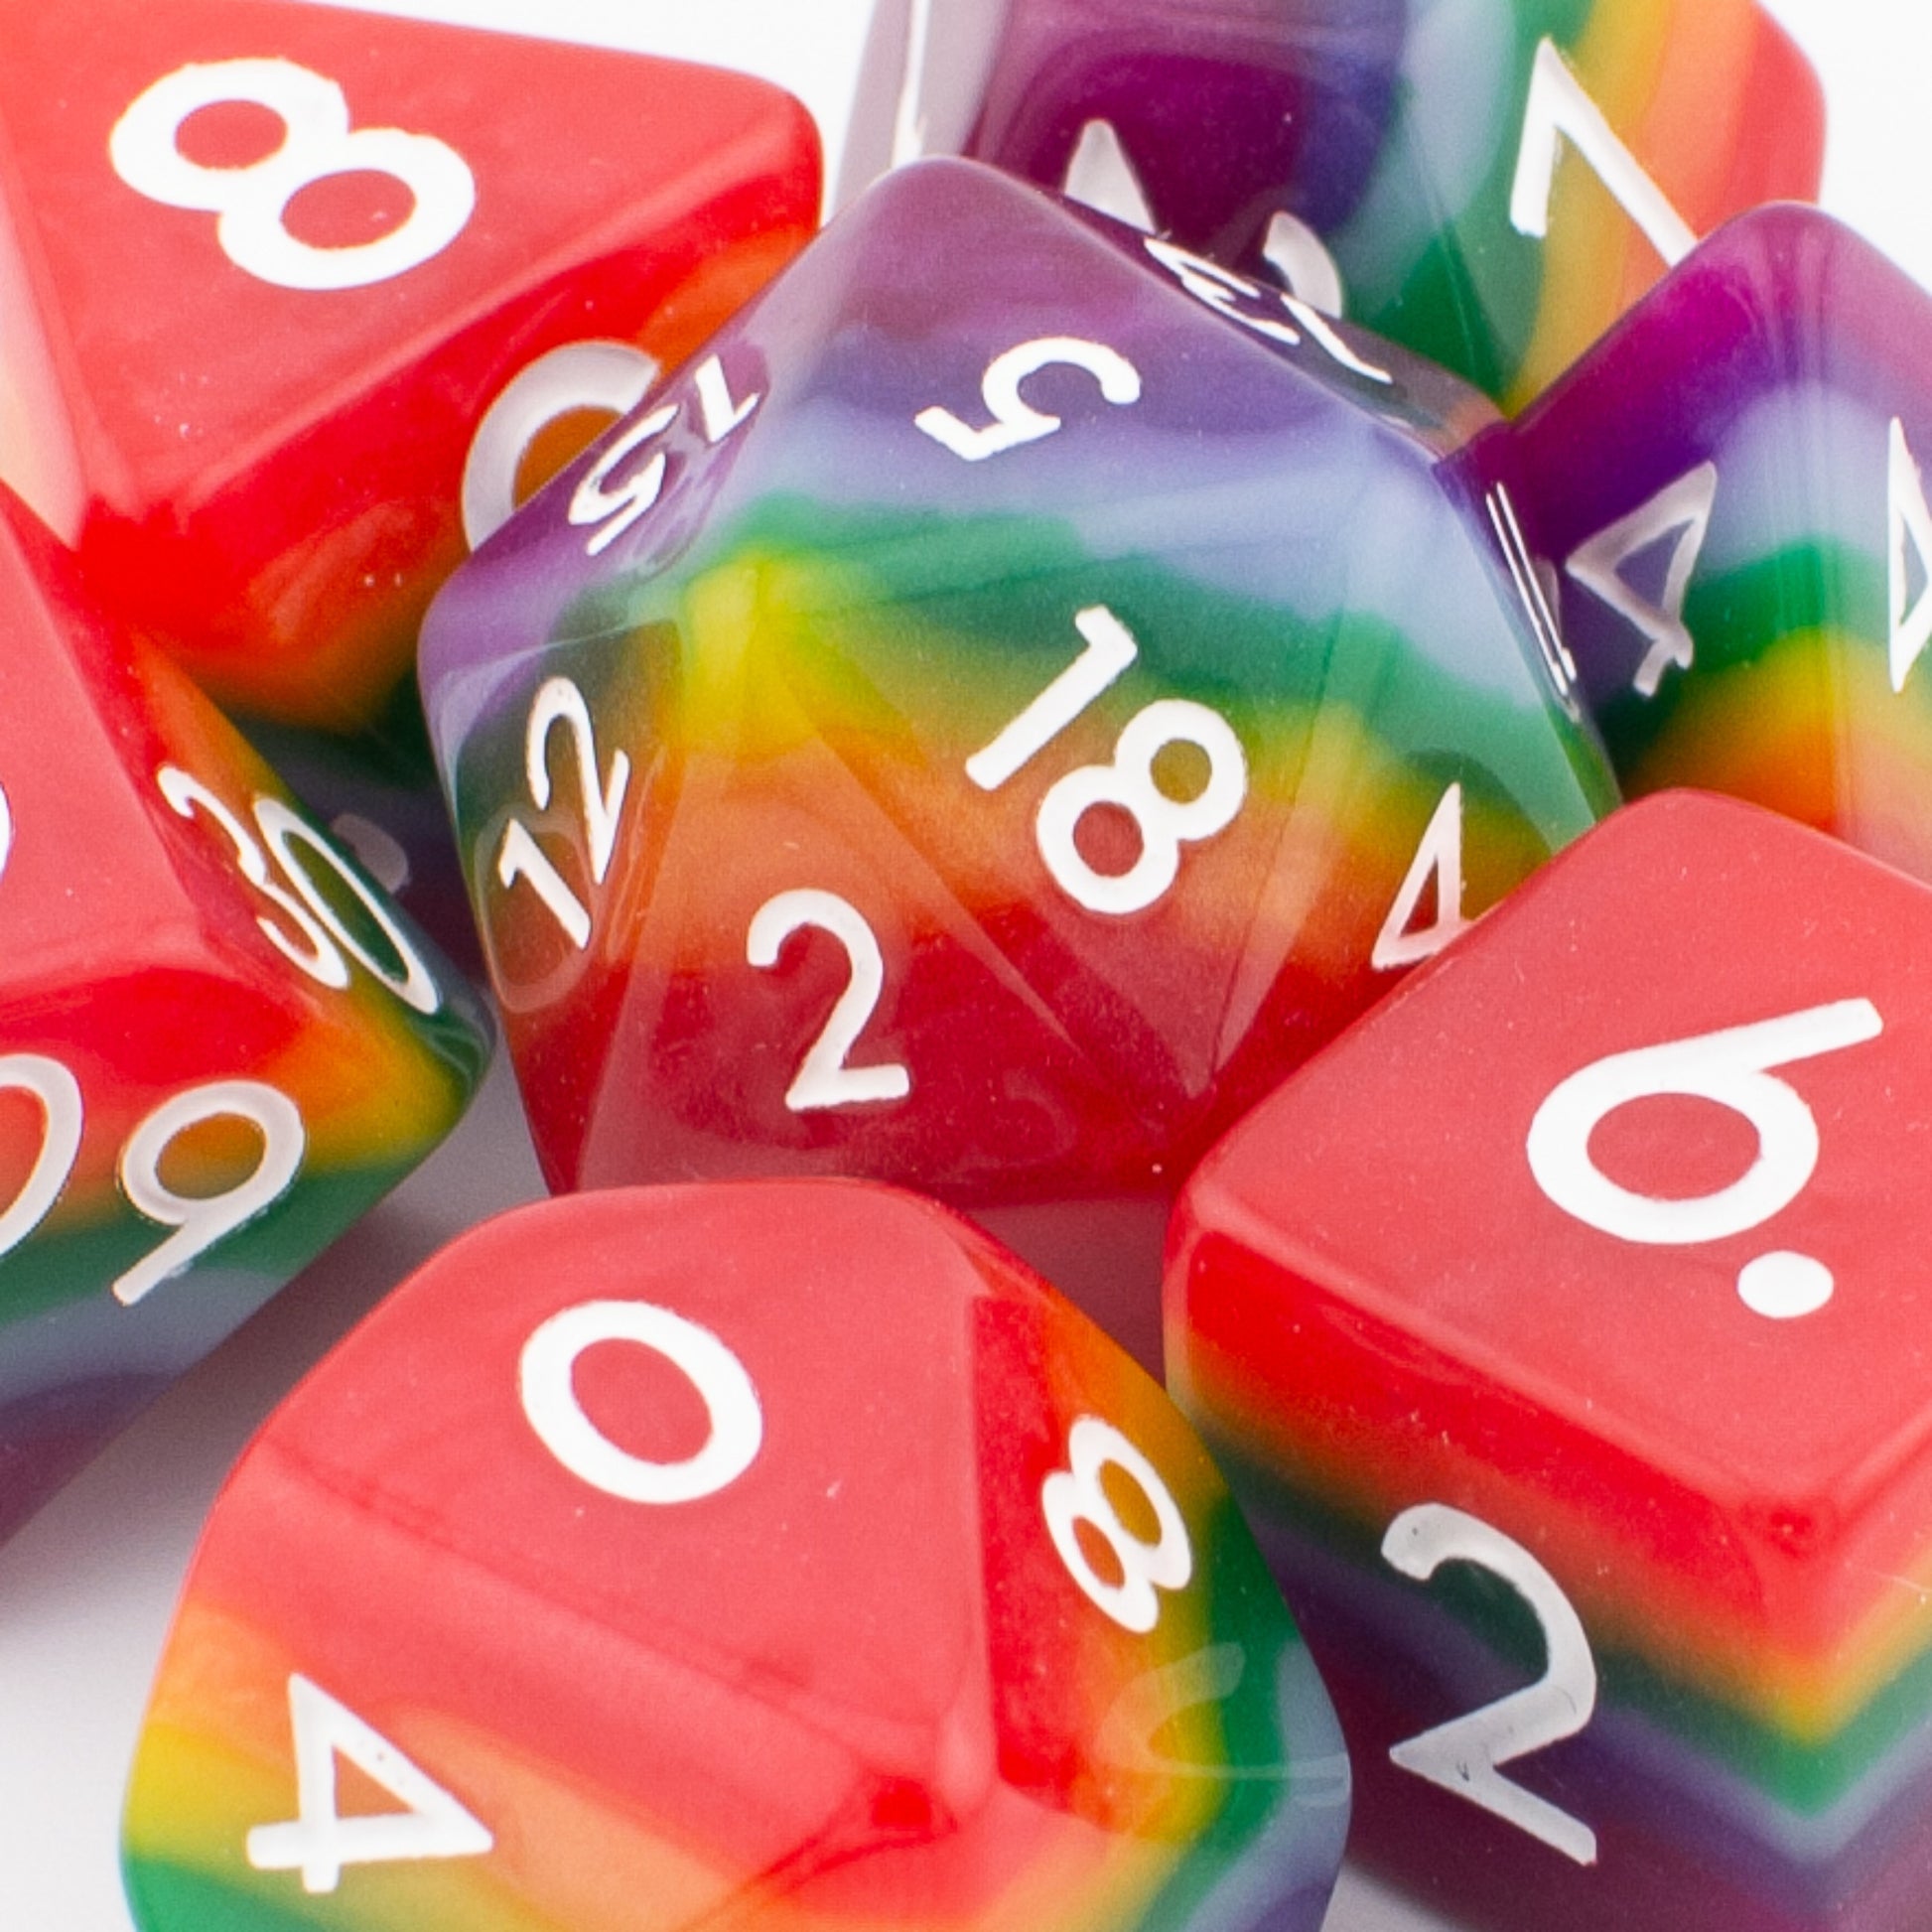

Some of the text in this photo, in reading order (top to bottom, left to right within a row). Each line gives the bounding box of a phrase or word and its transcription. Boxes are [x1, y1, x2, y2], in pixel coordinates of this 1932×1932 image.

[109, 58, 476, 290] 8
[567, 352, 759, 557] 15
[914, 336, 1141, 462] 5
[1565, 461, 1718, 697] 4
[497, 676, 630, 950] 12
[965, 604, 1247, 915] 18
[157, 764, 443, 1016] 30
[746, 888, 910, 1111] 2
[517, 1299, 763, 1505] 0
[1041, 1413, 1191, 1634] 8
[245, 1672, 494, 1893] 4
[1380, 1502, 1597, 1866] 2
